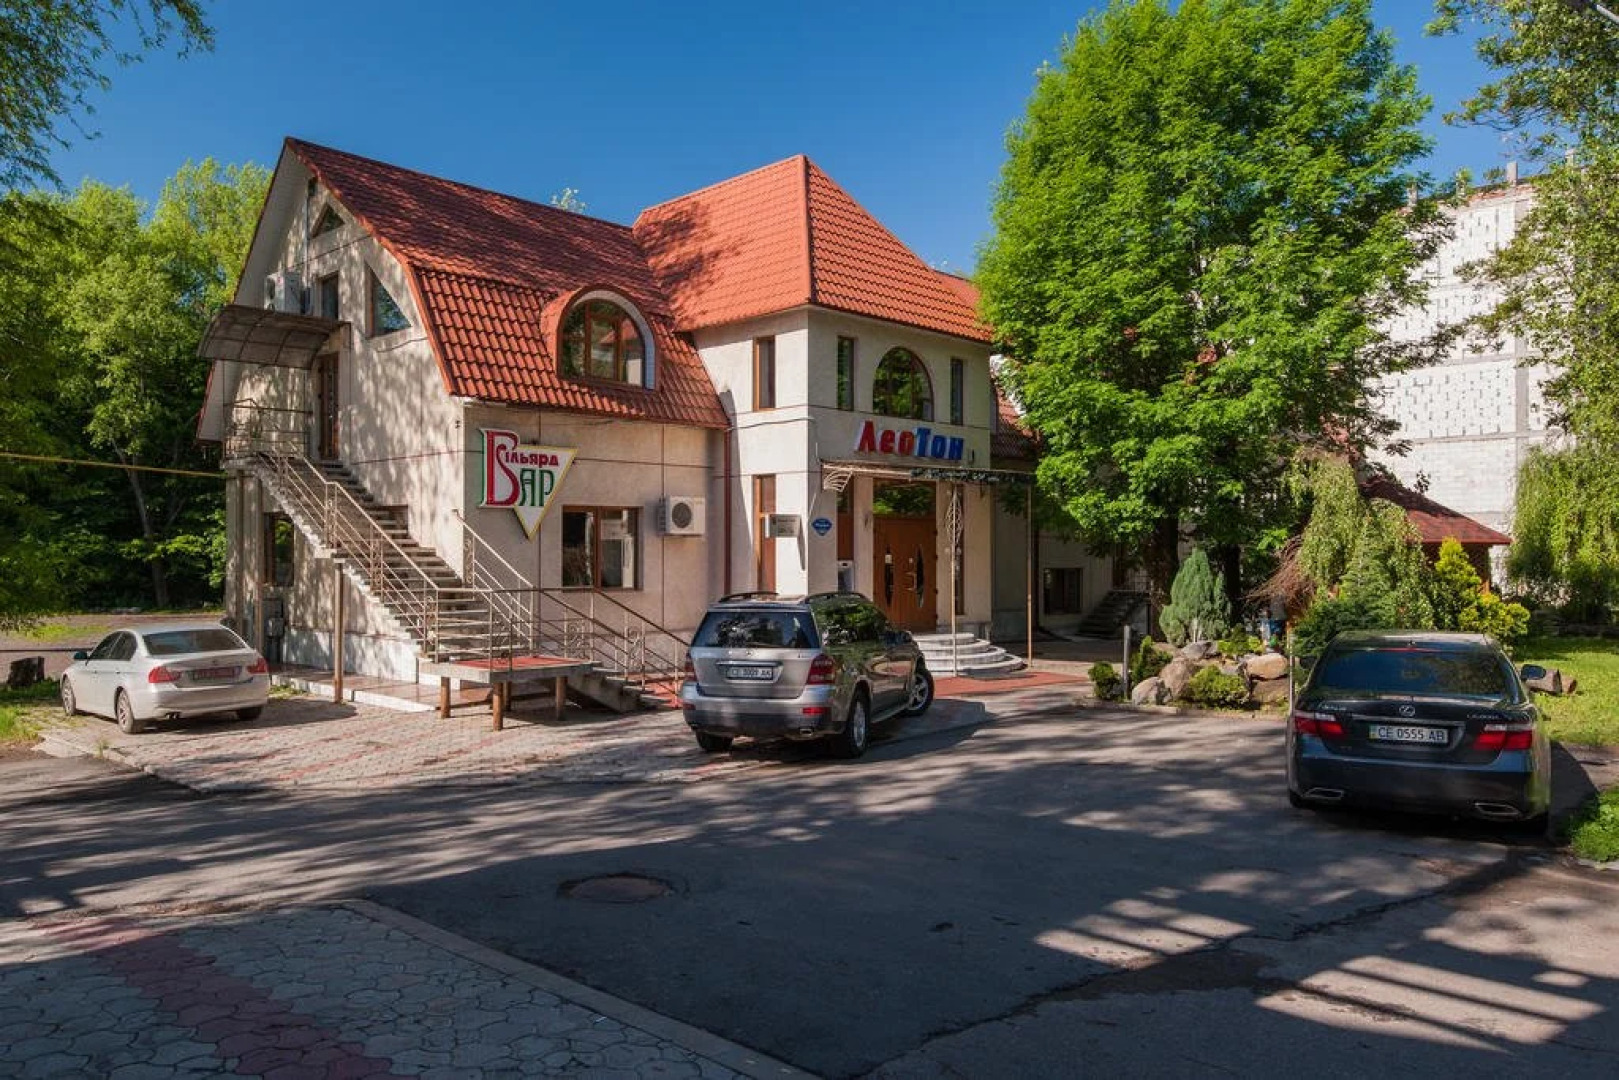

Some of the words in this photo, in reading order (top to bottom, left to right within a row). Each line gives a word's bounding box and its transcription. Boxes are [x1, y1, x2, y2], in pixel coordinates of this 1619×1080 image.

[856, 419, 964, 461] ЛеоТон
[1378, 726, 1394, 738] CE
[1397, 728, 1424, 739] 0555
